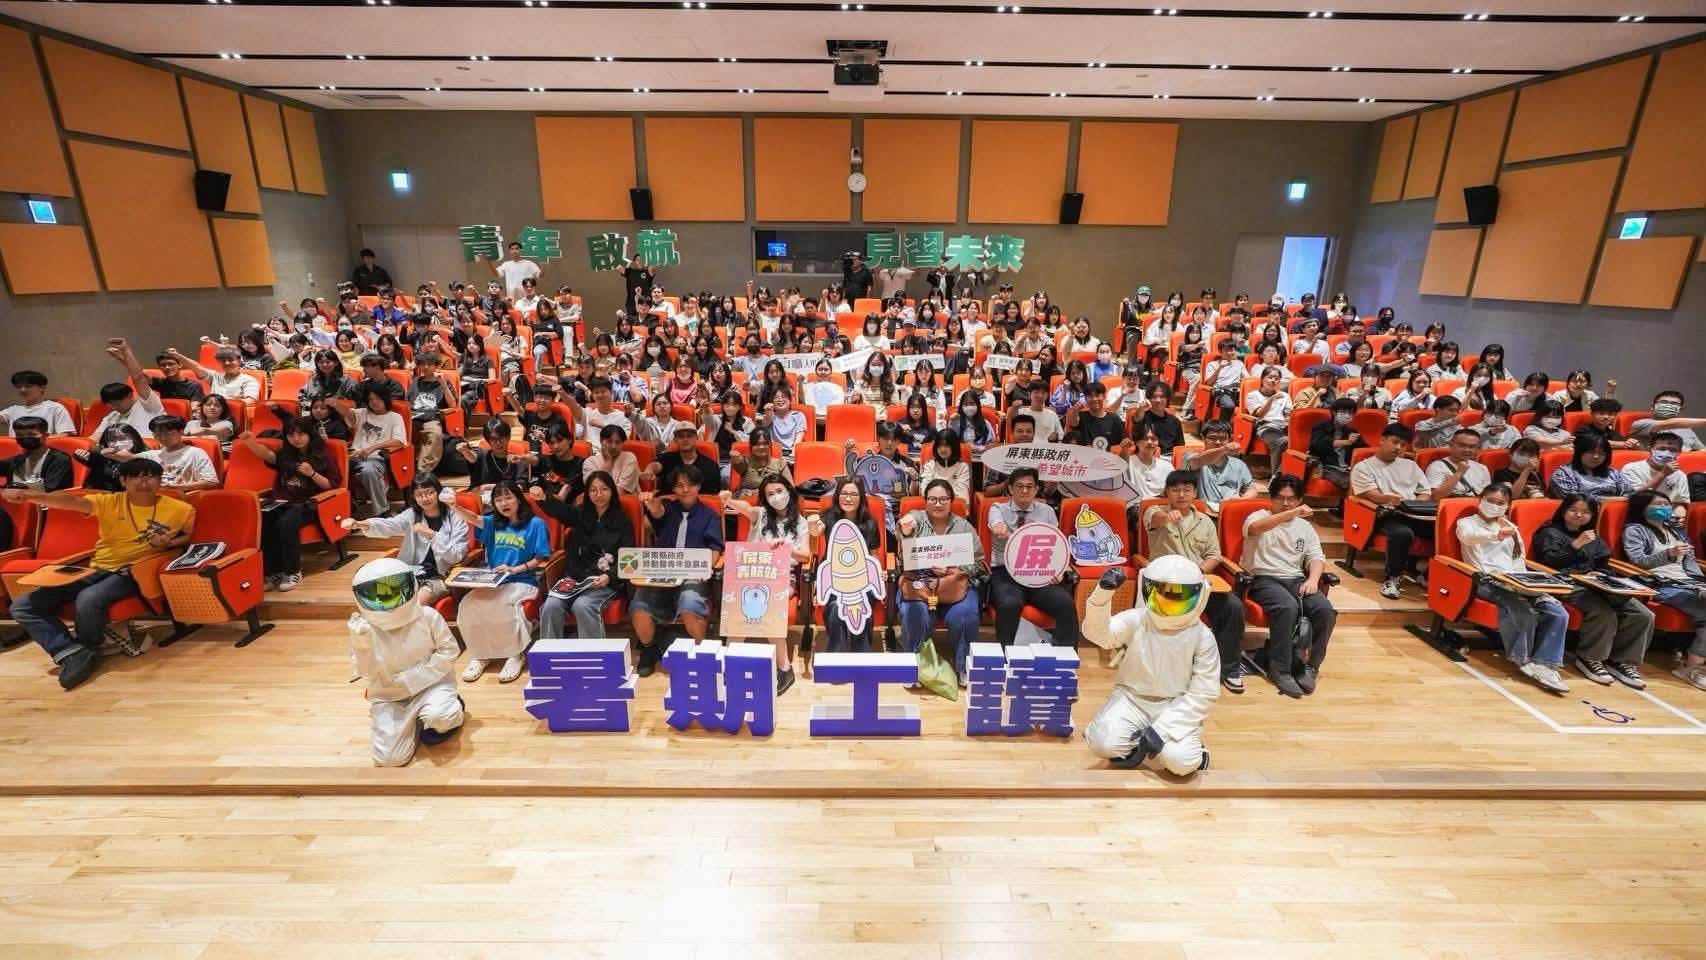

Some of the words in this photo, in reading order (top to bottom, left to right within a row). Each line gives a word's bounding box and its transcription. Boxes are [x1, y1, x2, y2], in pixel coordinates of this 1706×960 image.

[866, 231, 1025, 273] 見習未來
[1005, 447, 1072, 462] 屏東縣政府
[642, 551, 685, 560] 屏東縣政府
